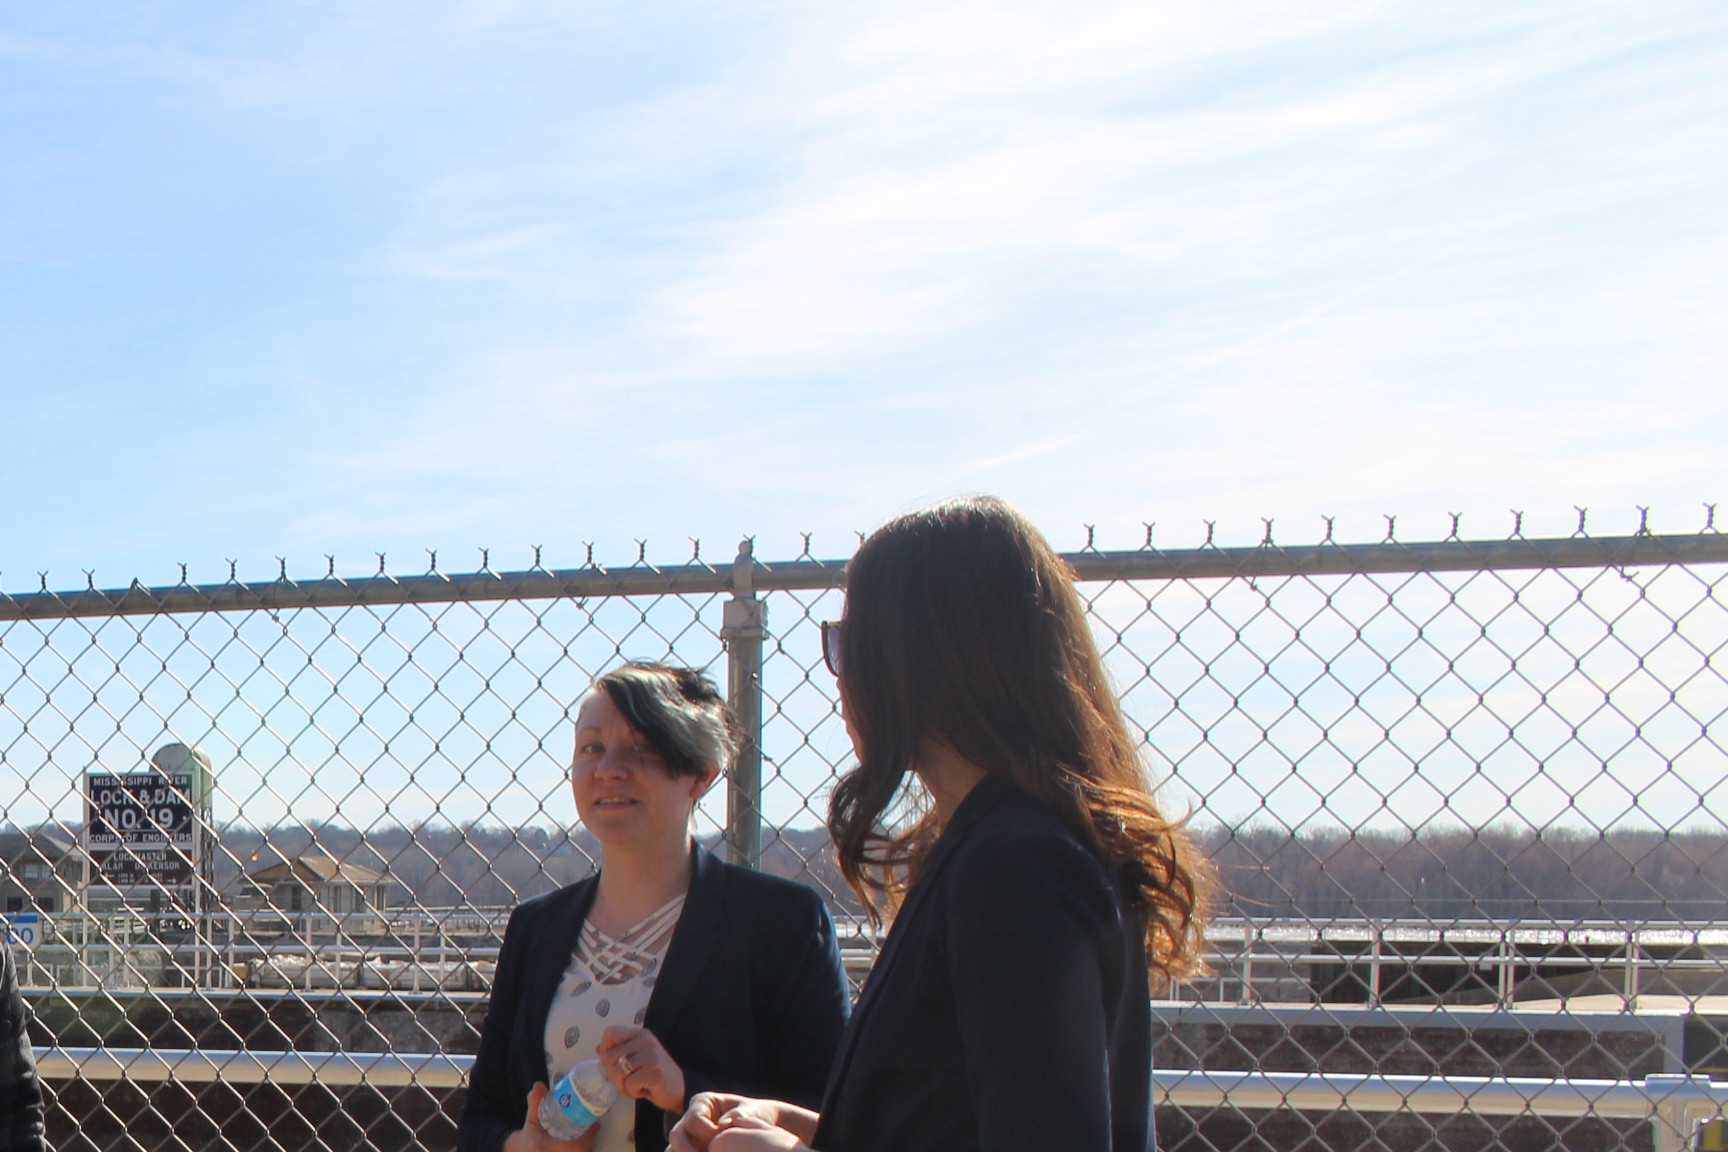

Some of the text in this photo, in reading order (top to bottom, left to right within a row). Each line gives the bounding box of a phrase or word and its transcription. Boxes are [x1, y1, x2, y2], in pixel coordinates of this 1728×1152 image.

[93, 776, 187, 786] MISSSIPPI RVER
[91, 788, 191, 805] LOCK & DAM
[149, 808, 174, 829] 19
[127, 833, 139, 842] OF
[142, 833, 192, 842] ENGIERS
